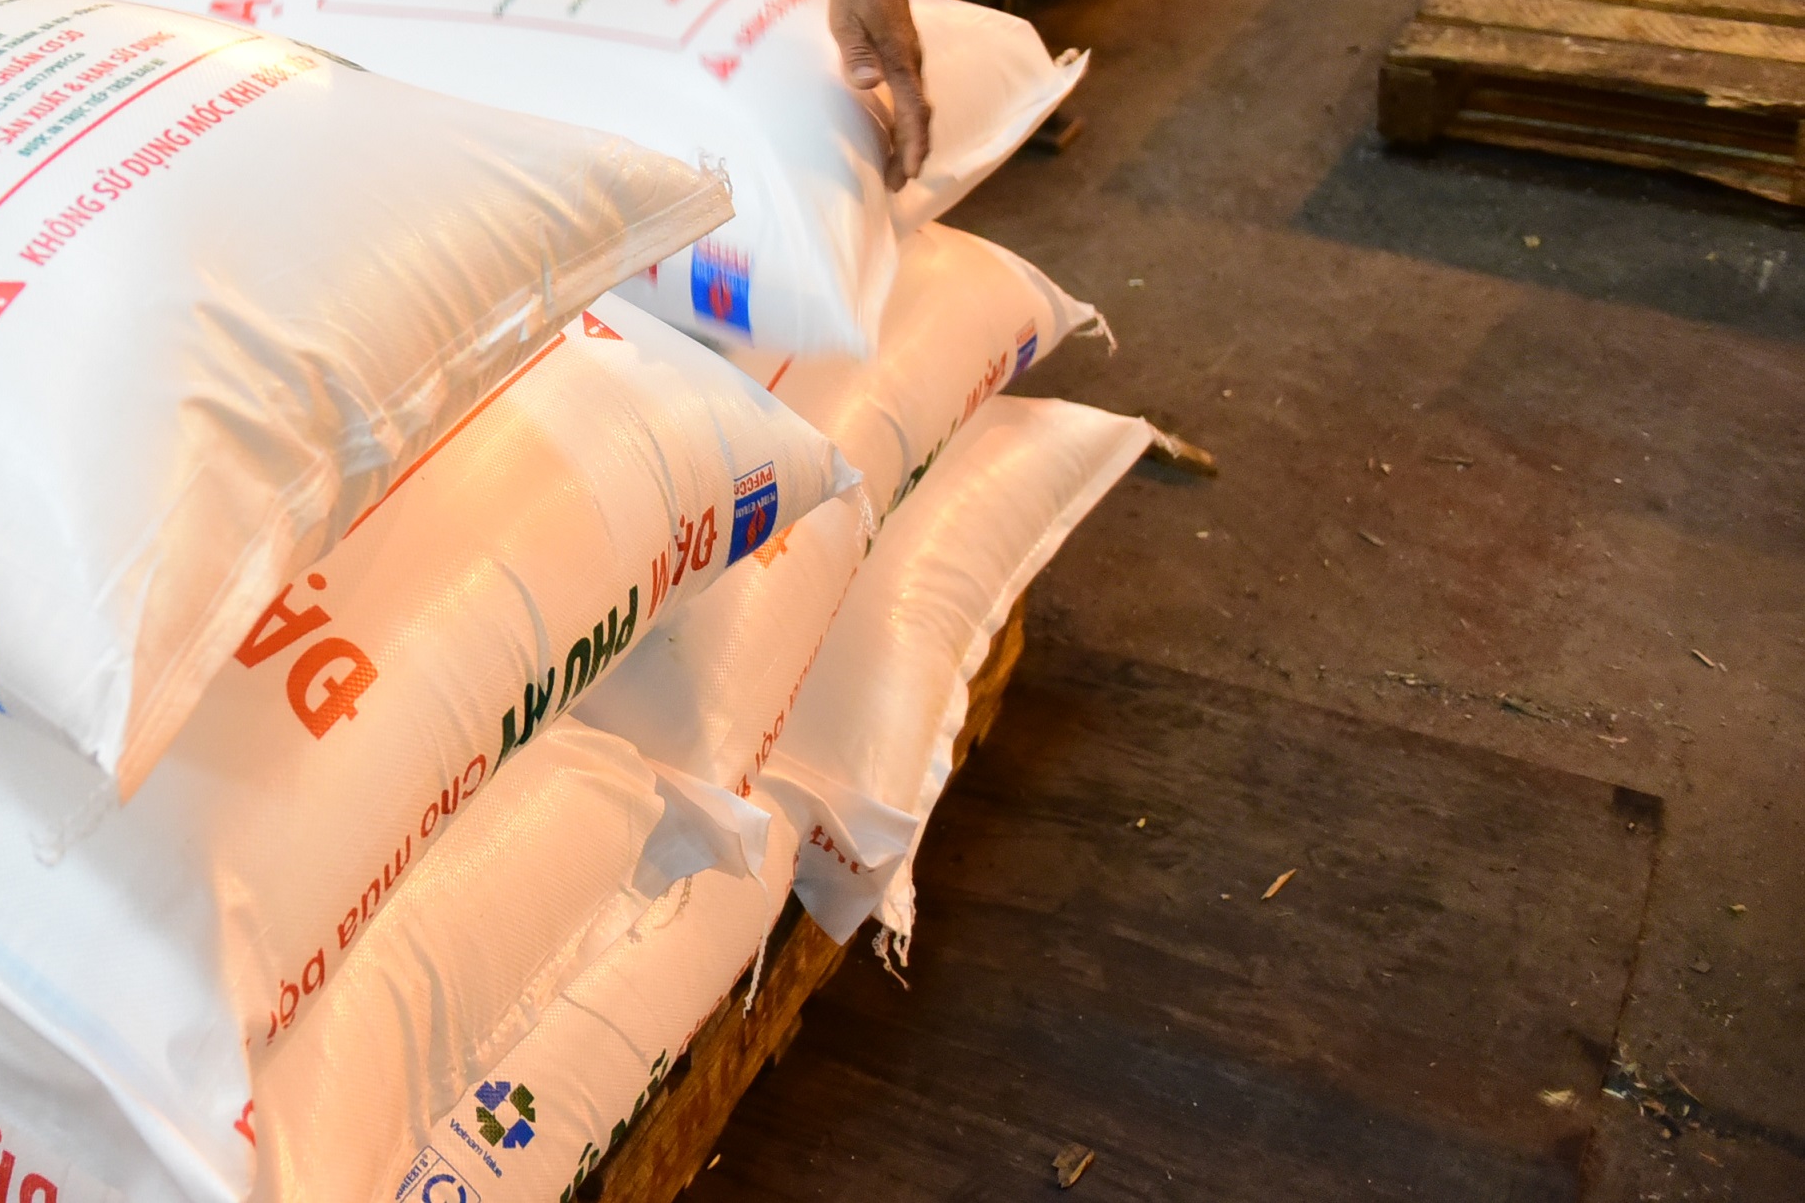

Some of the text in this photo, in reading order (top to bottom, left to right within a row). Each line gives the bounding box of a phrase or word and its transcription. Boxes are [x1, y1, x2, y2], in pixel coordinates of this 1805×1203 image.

[24, 90, 70, 120] XUẤT
[63, 82, 86, 92] &
[20, 80, 276, 266] KHÔNG SỬ DỤNG MÓC KHI
[647, 506, 718, 621] ĐẠM
[421, 754, 487, 839] Cho
[337, 835, 411, 950] mùa
[450, 1118, 504, 1179] Vietnam Value
